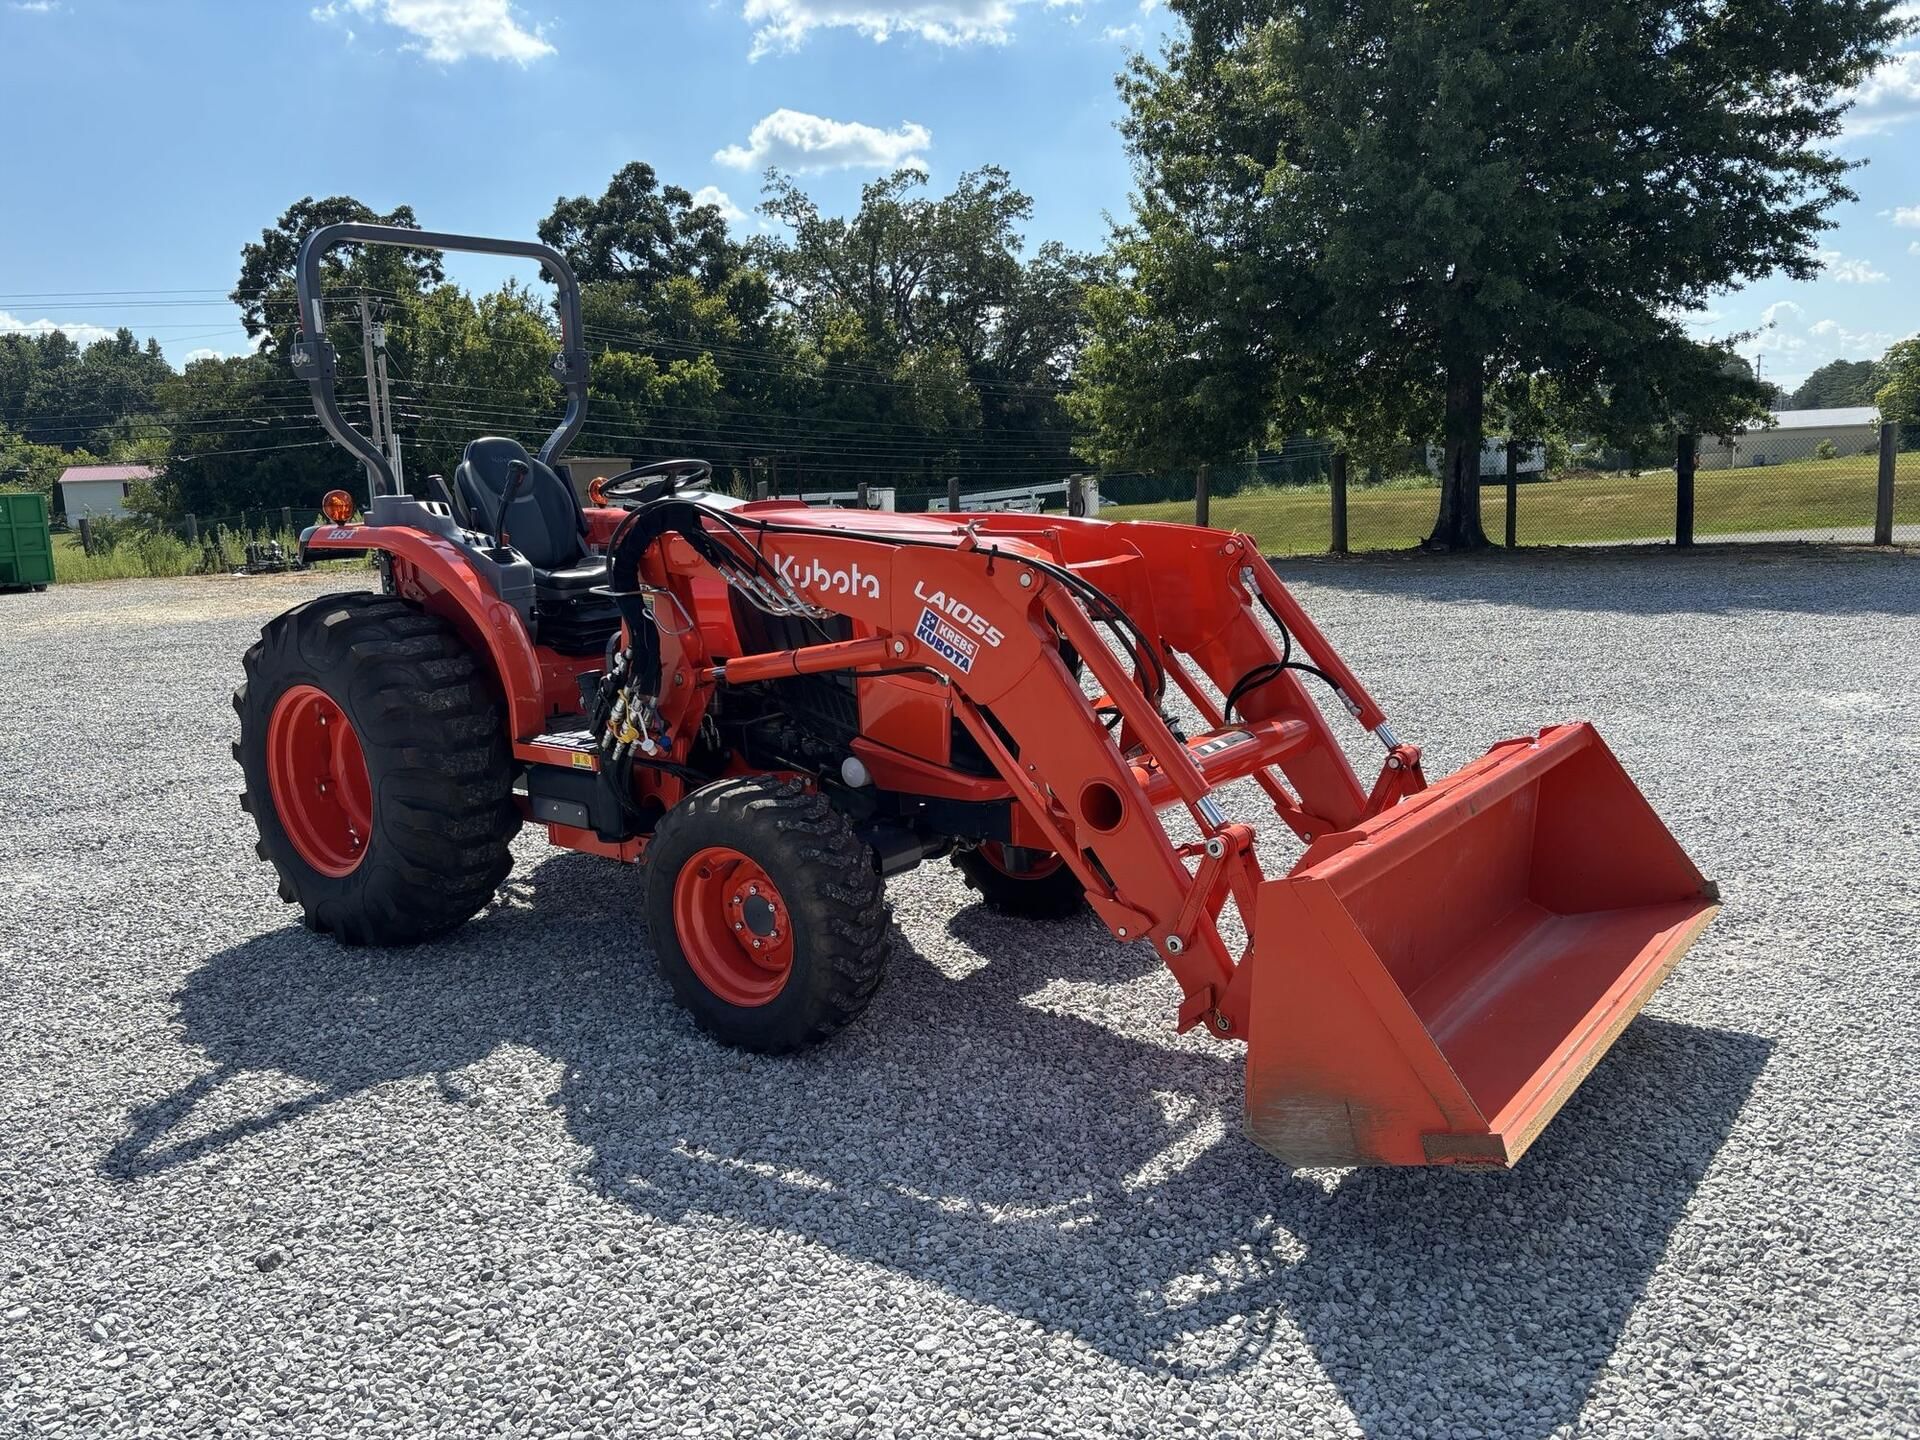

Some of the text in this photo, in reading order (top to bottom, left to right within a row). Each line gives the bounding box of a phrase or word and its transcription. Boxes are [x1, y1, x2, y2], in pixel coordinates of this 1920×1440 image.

[774, 553, 880, 598] Kubota
[914, 580, 1005, 647] LA1055
[916, 624, 970, 673] KUBOTA
[939, 623, 975, 656] KREBS
